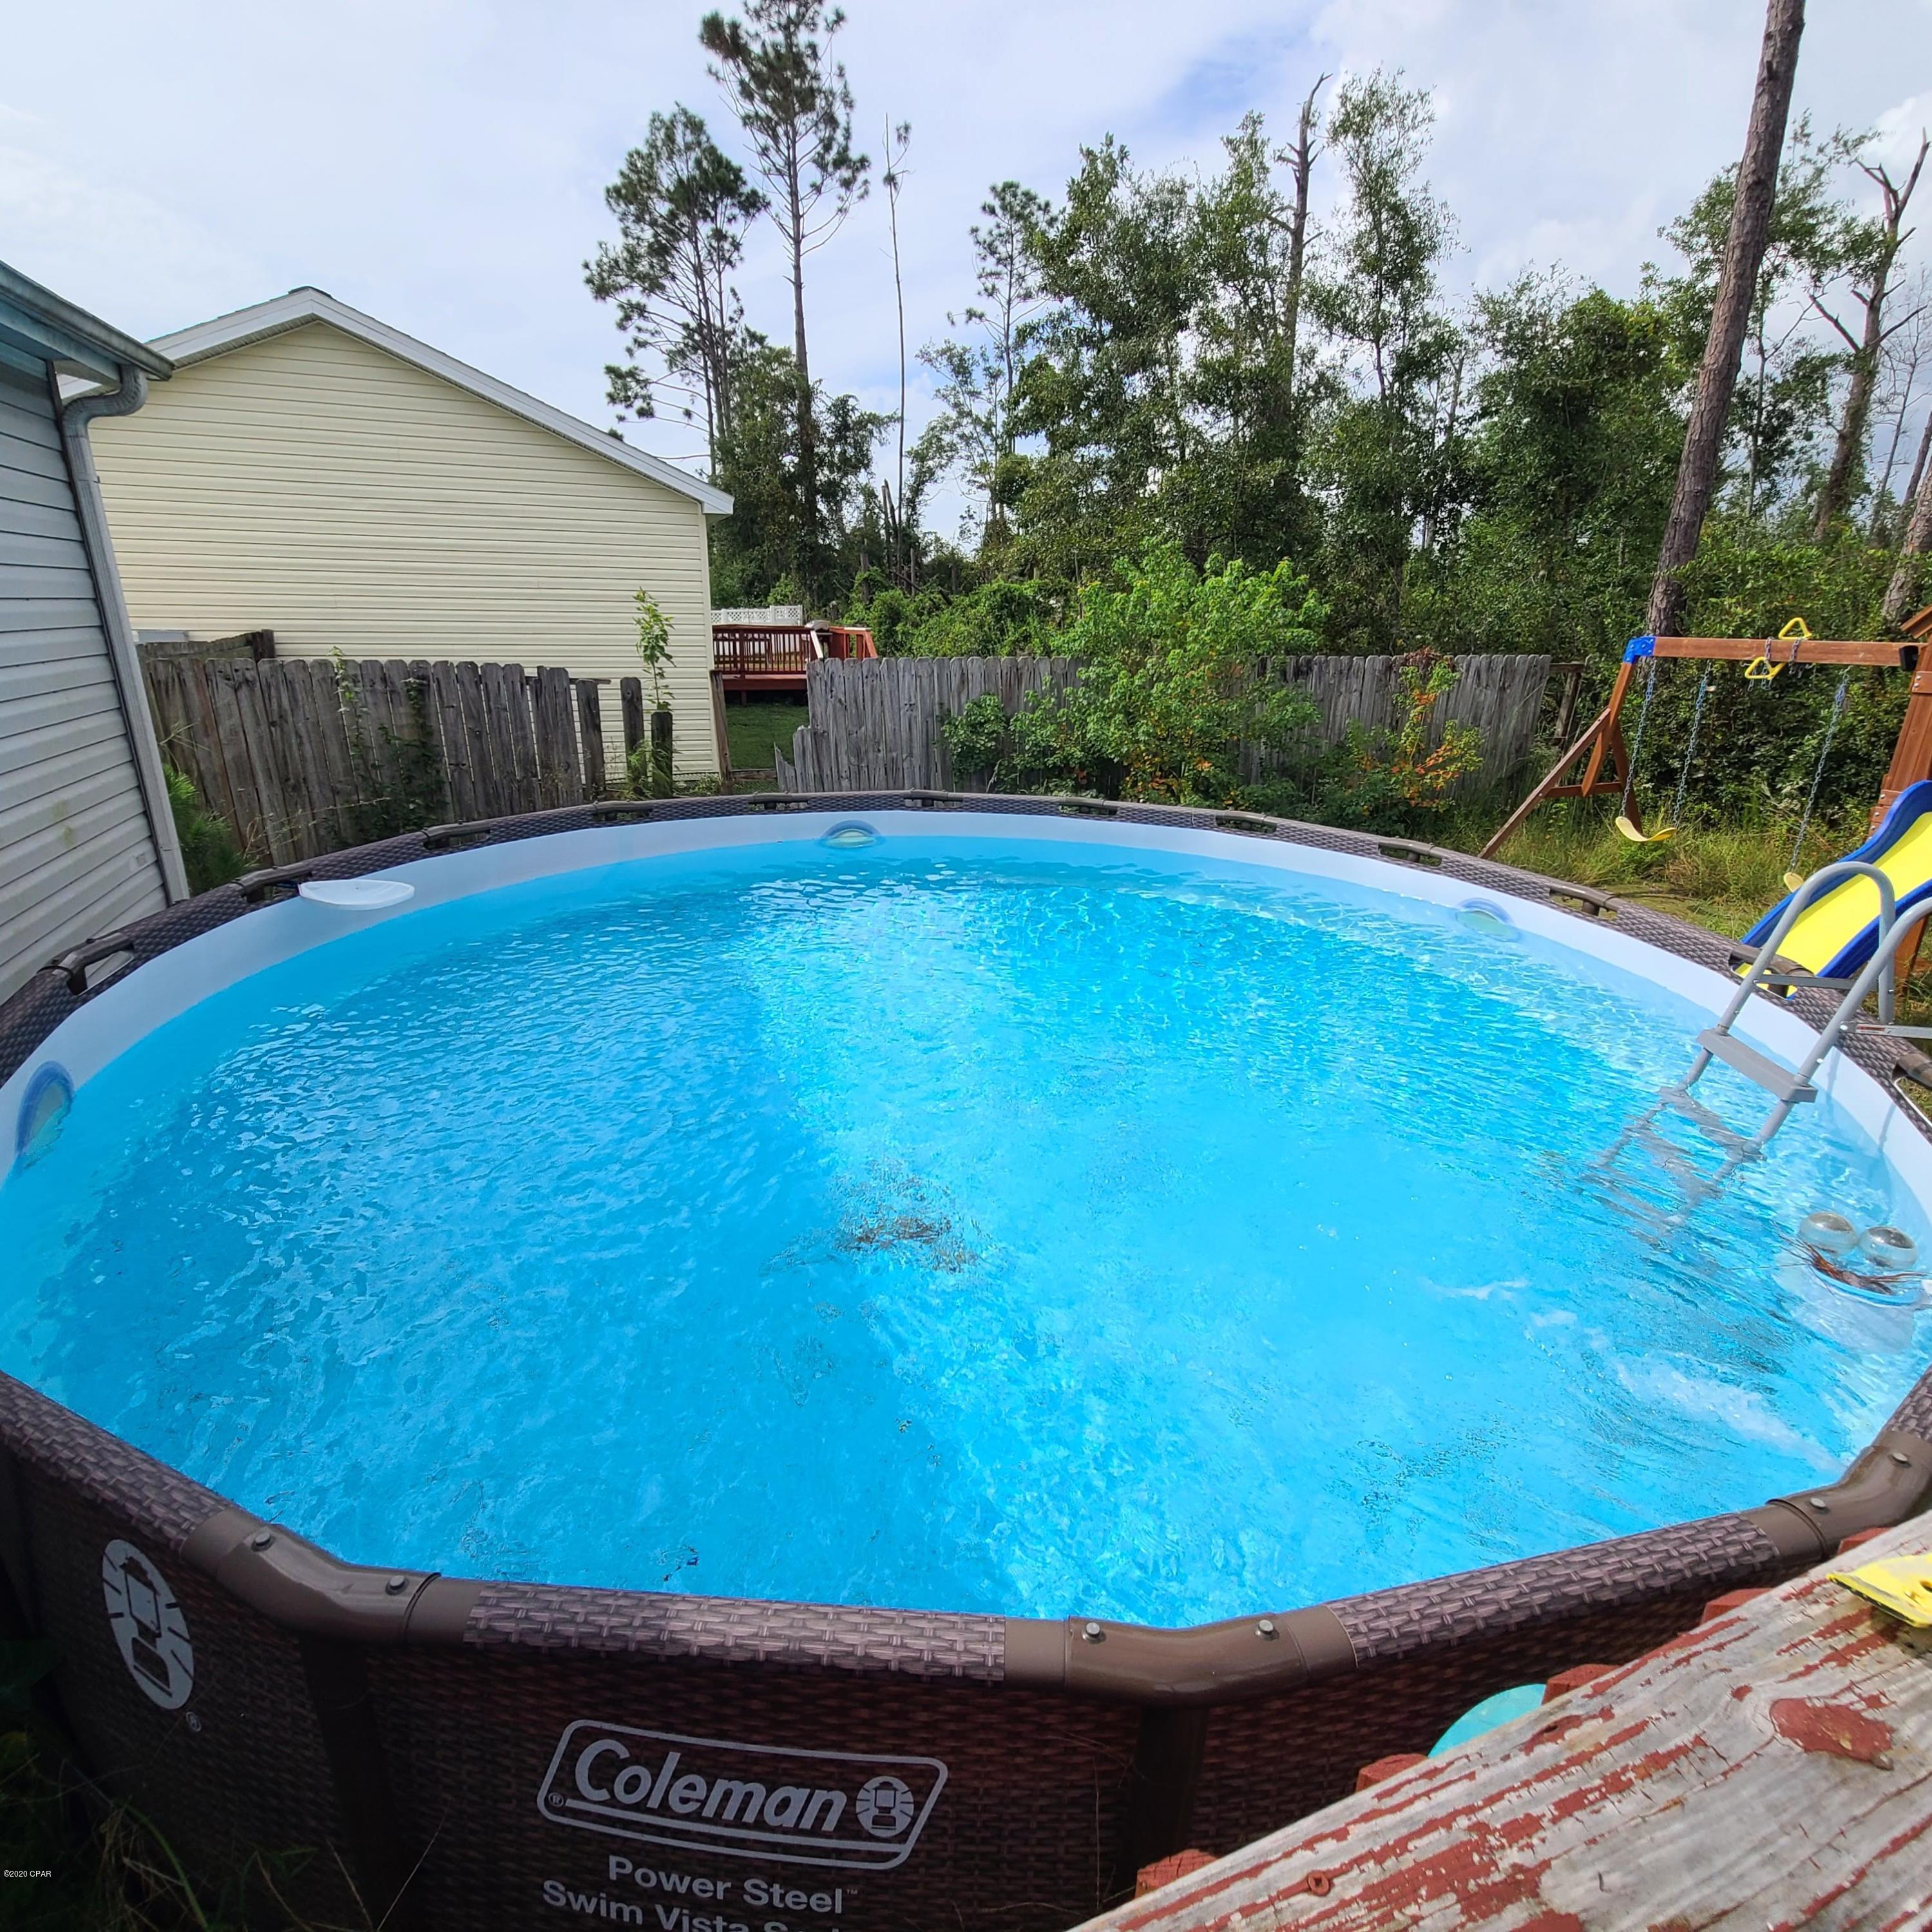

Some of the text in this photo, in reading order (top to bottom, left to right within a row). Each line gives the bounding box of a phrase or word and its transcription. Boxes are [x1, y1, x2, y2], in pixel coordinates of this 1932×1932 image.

[574, 1739, 848, 1832] Coleman
[608, 1855, 732, 1900] Power
[542, 1880, 644, 1926] Swim
